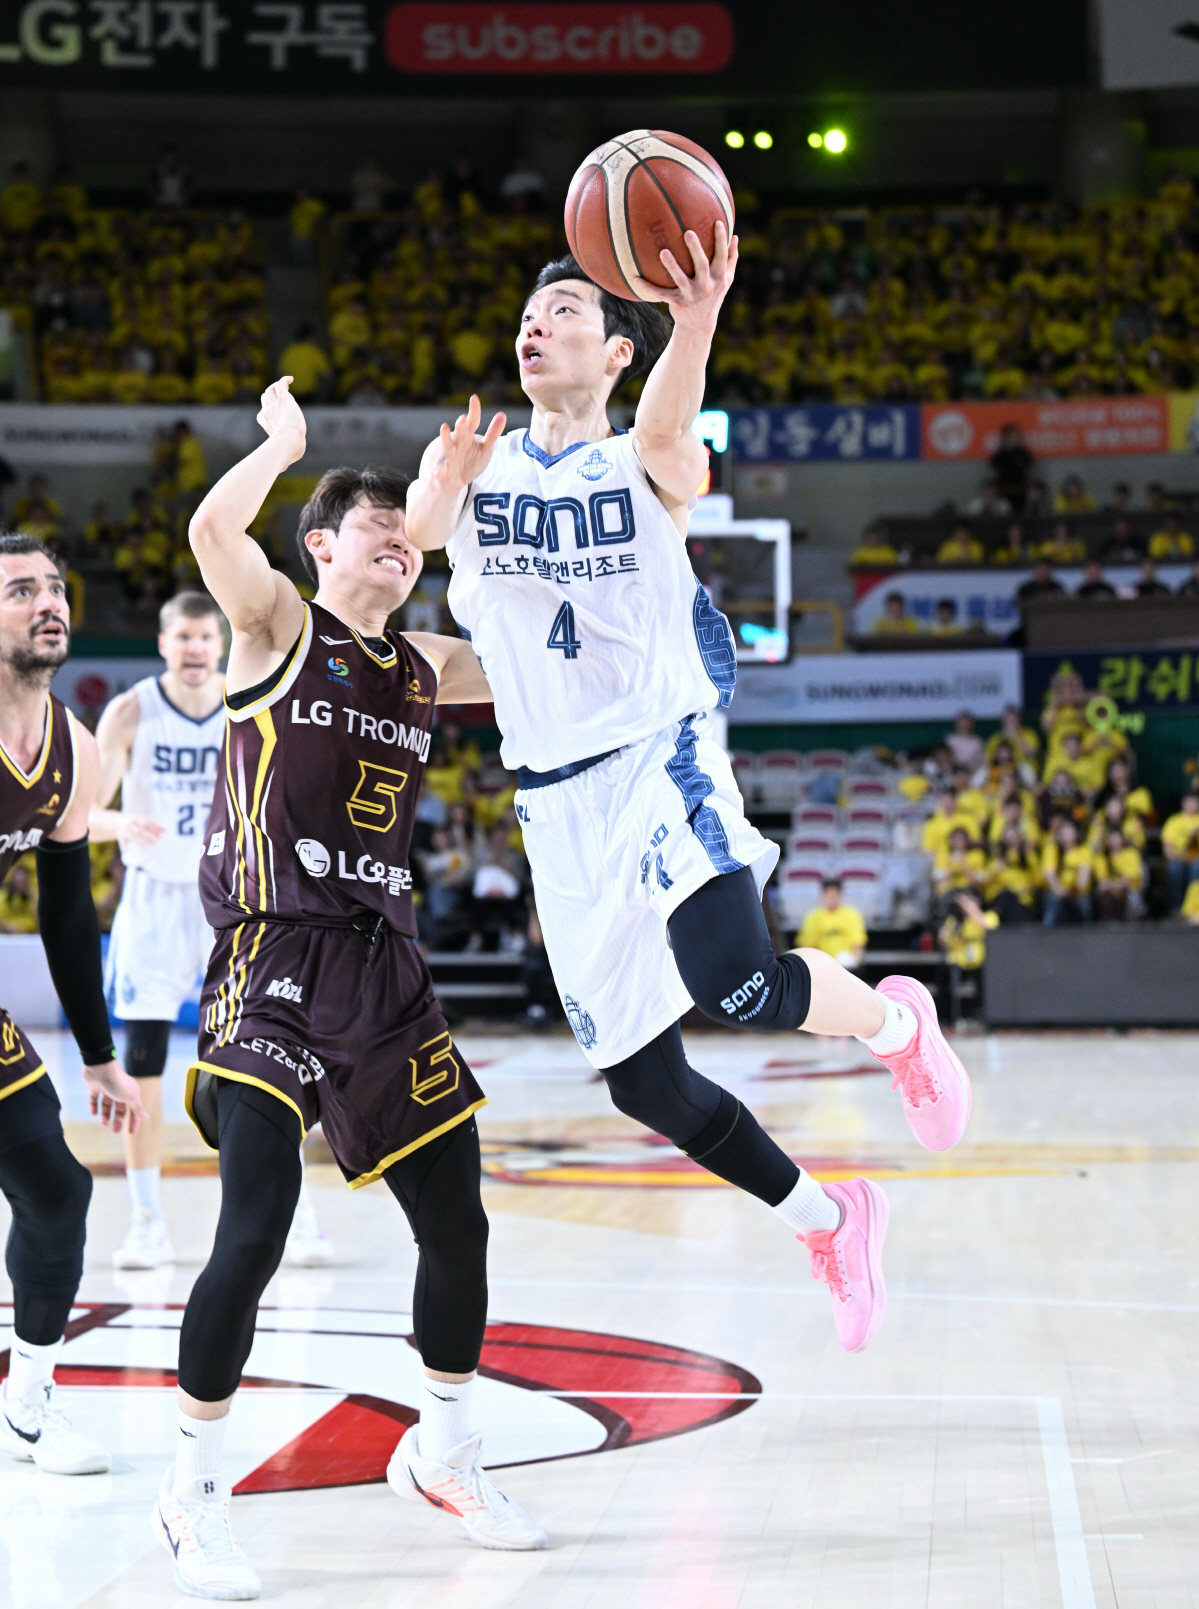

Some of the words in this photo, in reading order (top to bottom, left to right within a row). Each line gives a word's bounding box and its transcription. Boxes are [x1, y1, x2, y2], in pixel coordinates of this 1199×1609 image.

[245, 4, 375, 72] 구독
[421, 22, 705, 61] subscribe
[546, 600, 582, 659] 4
[291, 699, 333, 726] LG
[152, 743, 222, 774] SON
[346, 760, 408, 833] 5
[408, 1030, 460, 1106] 5
